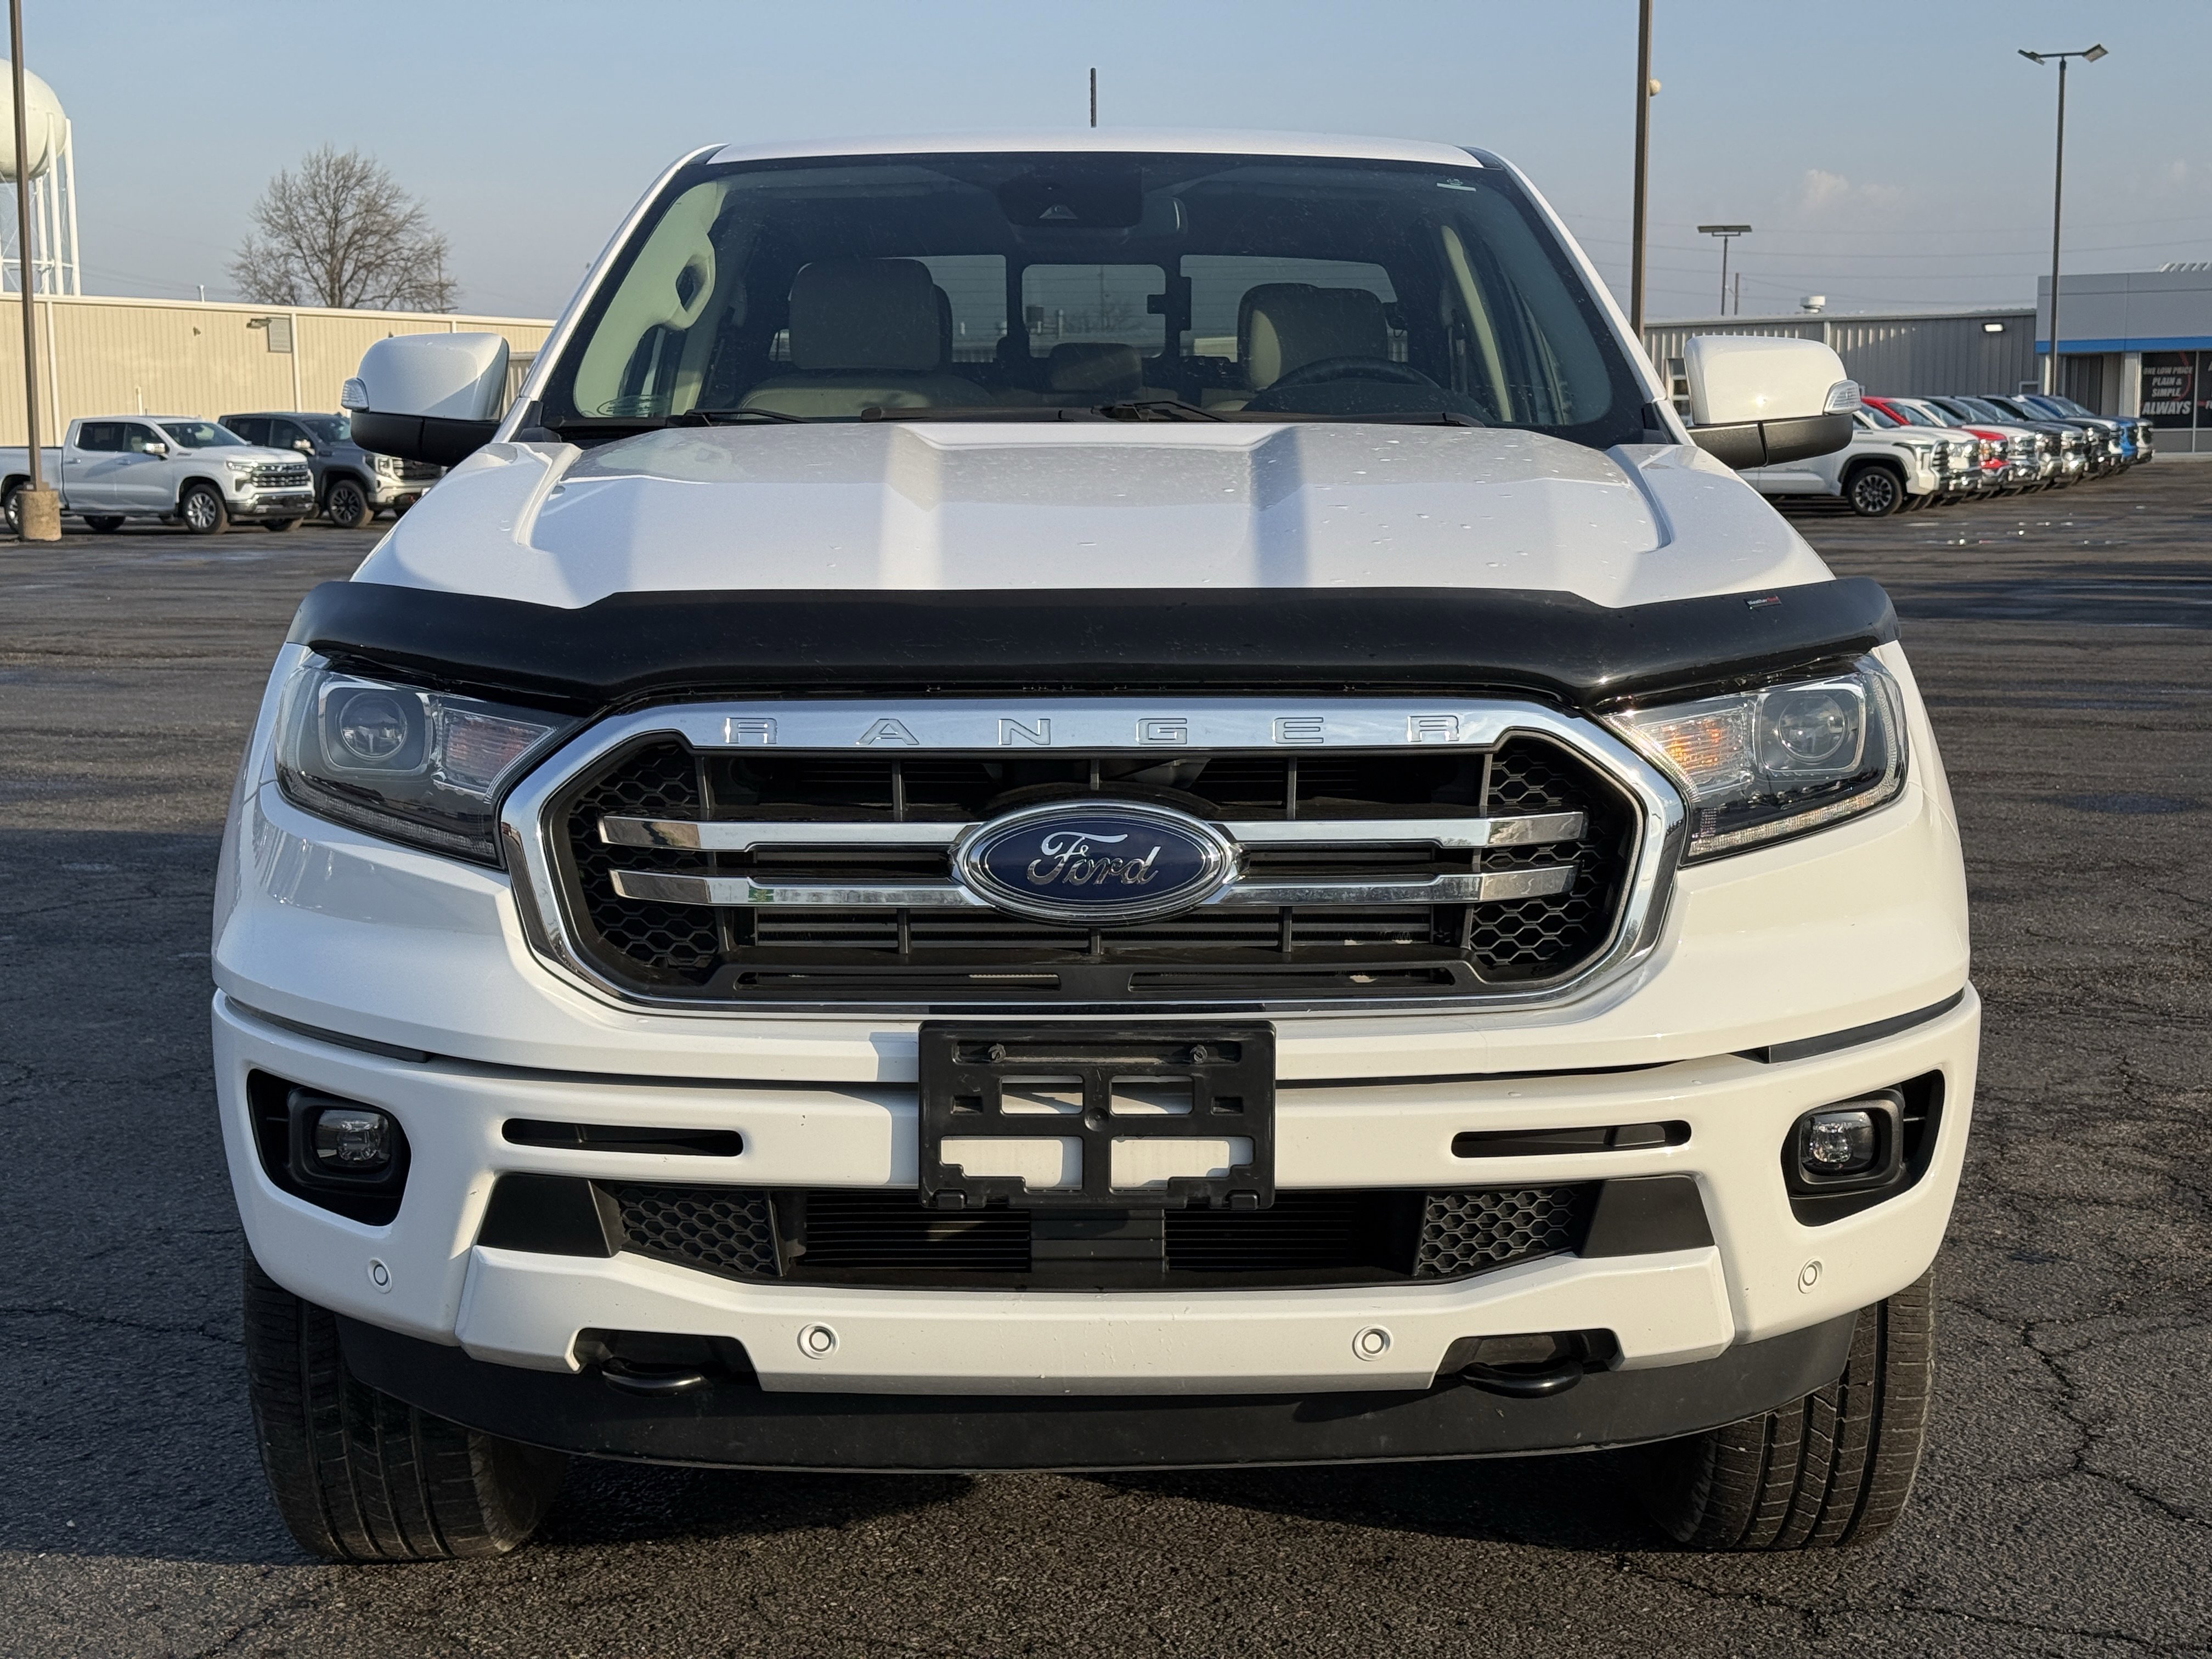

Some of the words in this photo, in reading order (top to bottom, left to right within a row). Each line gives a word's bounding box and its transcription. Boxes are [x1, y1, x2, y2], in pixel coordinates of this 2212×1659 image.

[2157, 366, 2172, 375] LOW
[2172, 366, 2193, 375] PRICE
[2152, 377, 2175, 386] PLAIN
[2142, 401, 2191, 415] ALWAYS
[725, 715, 1460, 746] RANGER
[1026, 831, 1161, 886] Ford
